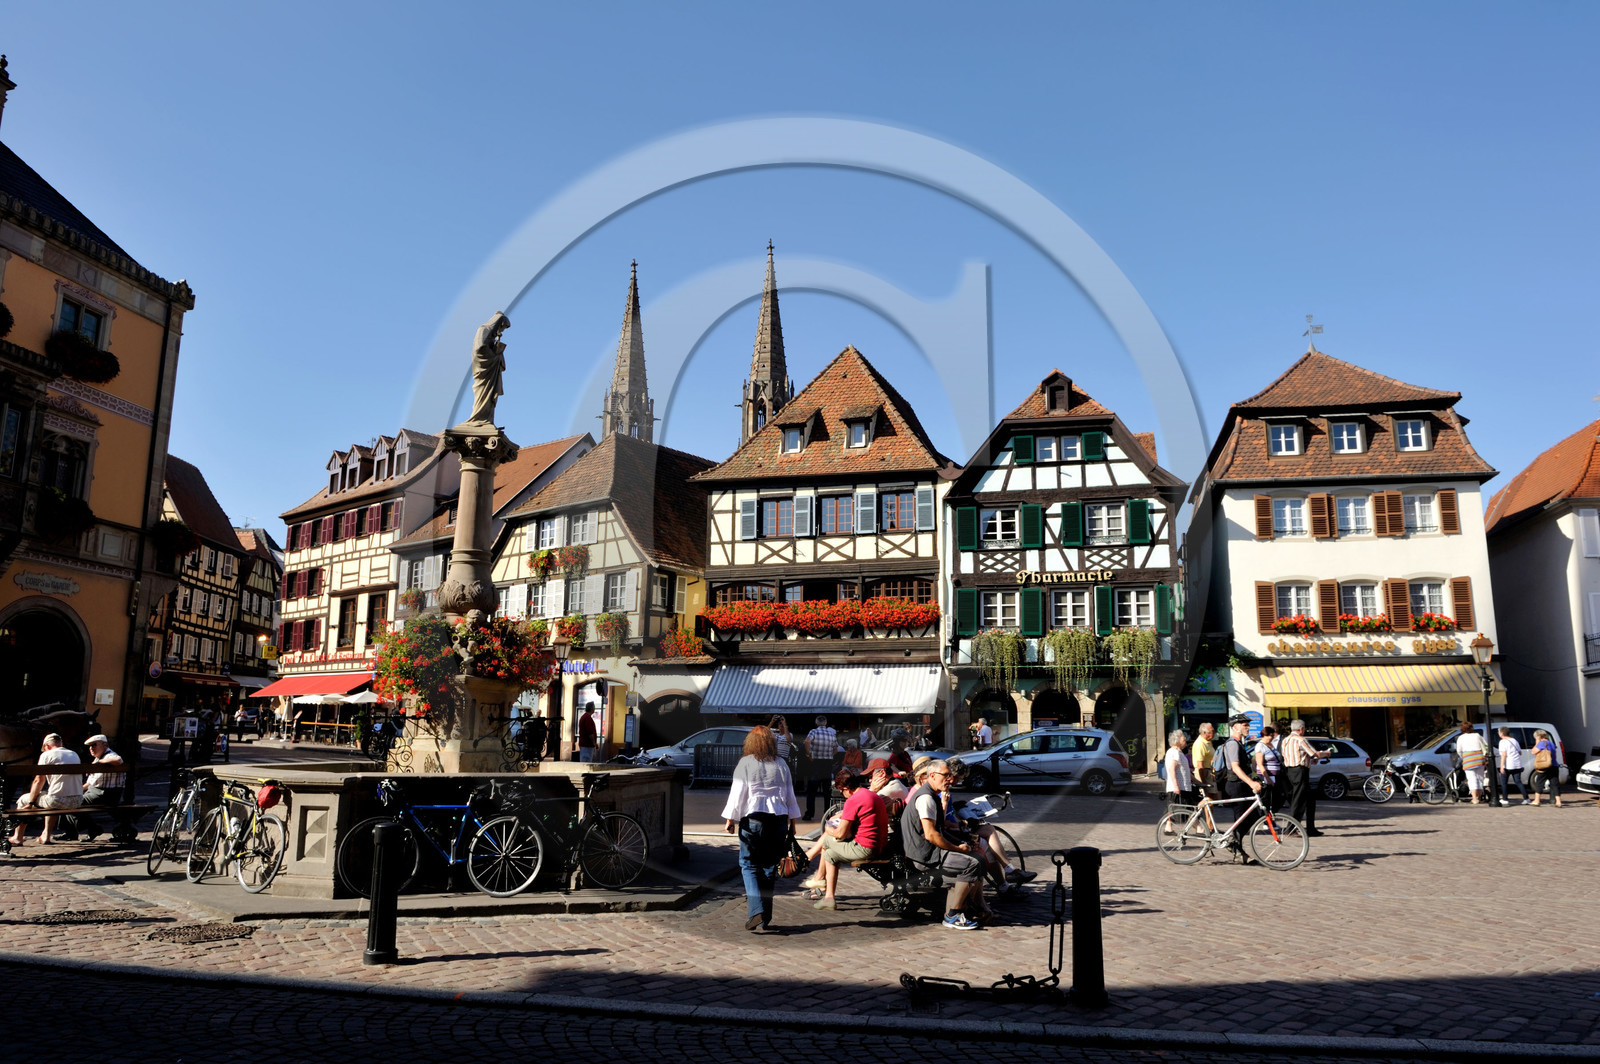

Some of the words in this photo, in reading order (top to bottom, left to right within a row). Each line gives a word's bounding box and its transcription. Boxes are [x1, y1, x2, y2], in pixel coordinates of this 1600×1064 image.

[25, 576, 46, 587] CORPS
[51, 580, 71, 591] GARDE
[1015, 567, 1113, 584] Pharmacie
[1267, 638, 1396, 654] chaussures
[1411, 637, 1458, 654] gyss
[1347, 695, 1397, 704] chaussures
[1401, 695, 1422, 705] gyss
